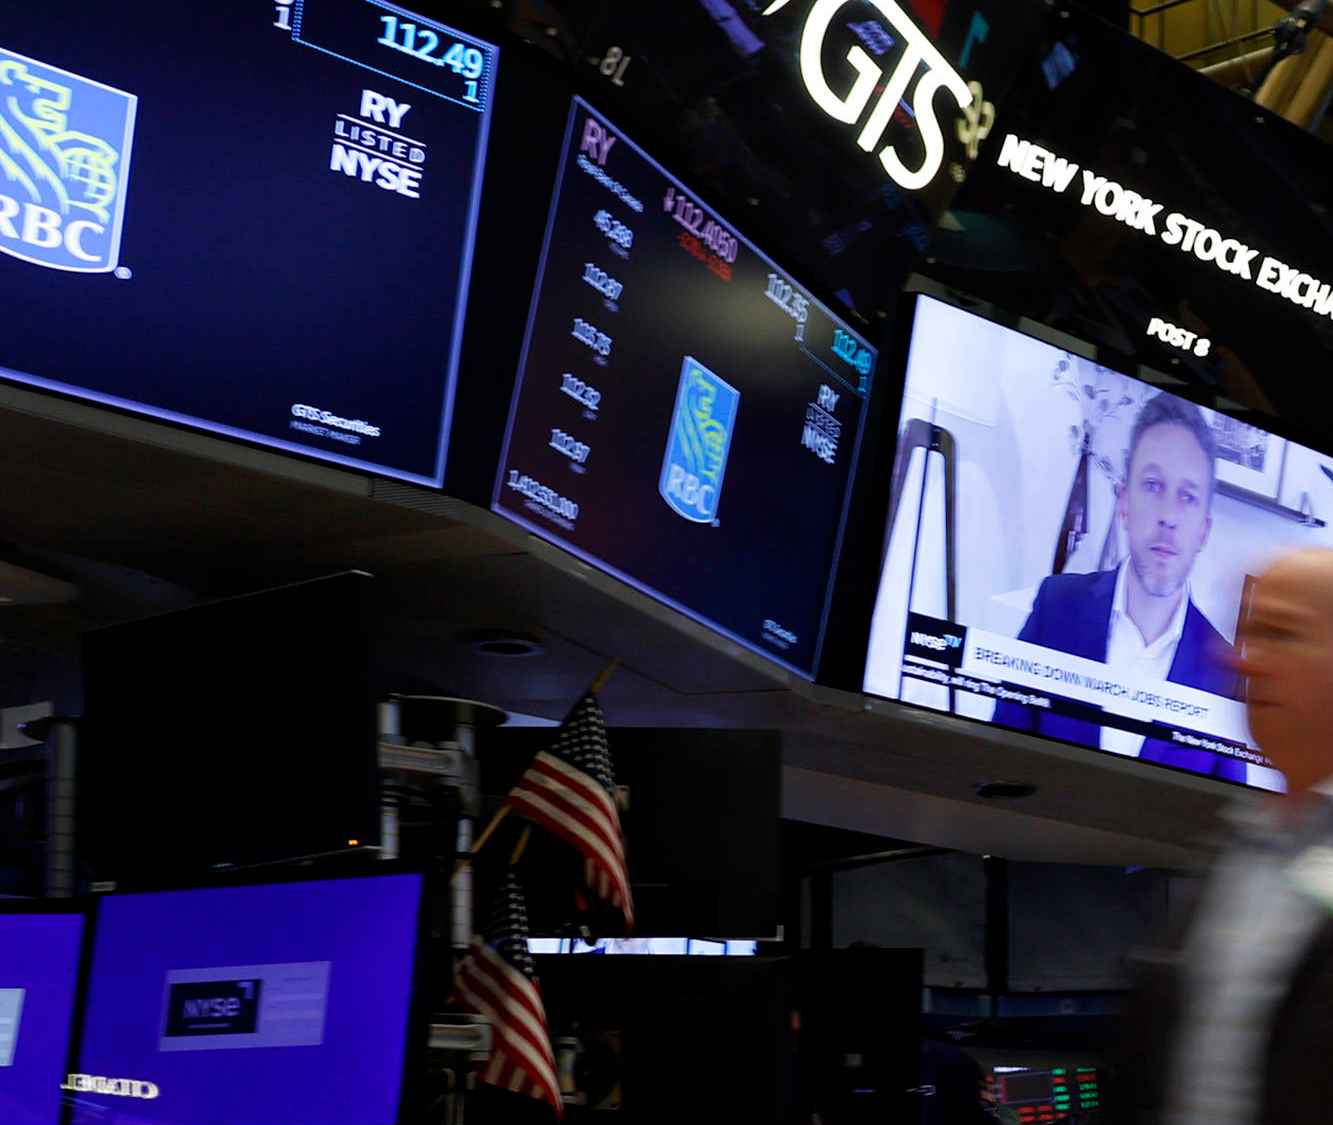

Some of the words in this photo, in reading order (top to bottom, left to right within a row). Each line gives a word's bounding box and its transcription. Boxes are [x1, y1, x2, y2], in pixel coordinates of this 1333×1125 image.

[377, 15, 483, 79] 112.49
[360, 89, 411, 129] RY
[462, 80, 480, 103] 1
[800, 0, 974, 191] GTS
[334, 120, 426, 163] LISTED
[580, 117, 616, 166] RY
[330, 143, 422, 198] NYSE
[672, 196, 738, 264] 112.4050
[998, 134, 1078, 192] NEW
[1080, 168, 1156, 237] YORK
[1161, 211, 1256, 281] STOCK
[1147, 317, 1197, 351] POST
[665, 463, 716, 519] RBC
[975, 647, 1041, 677] BREAKING
